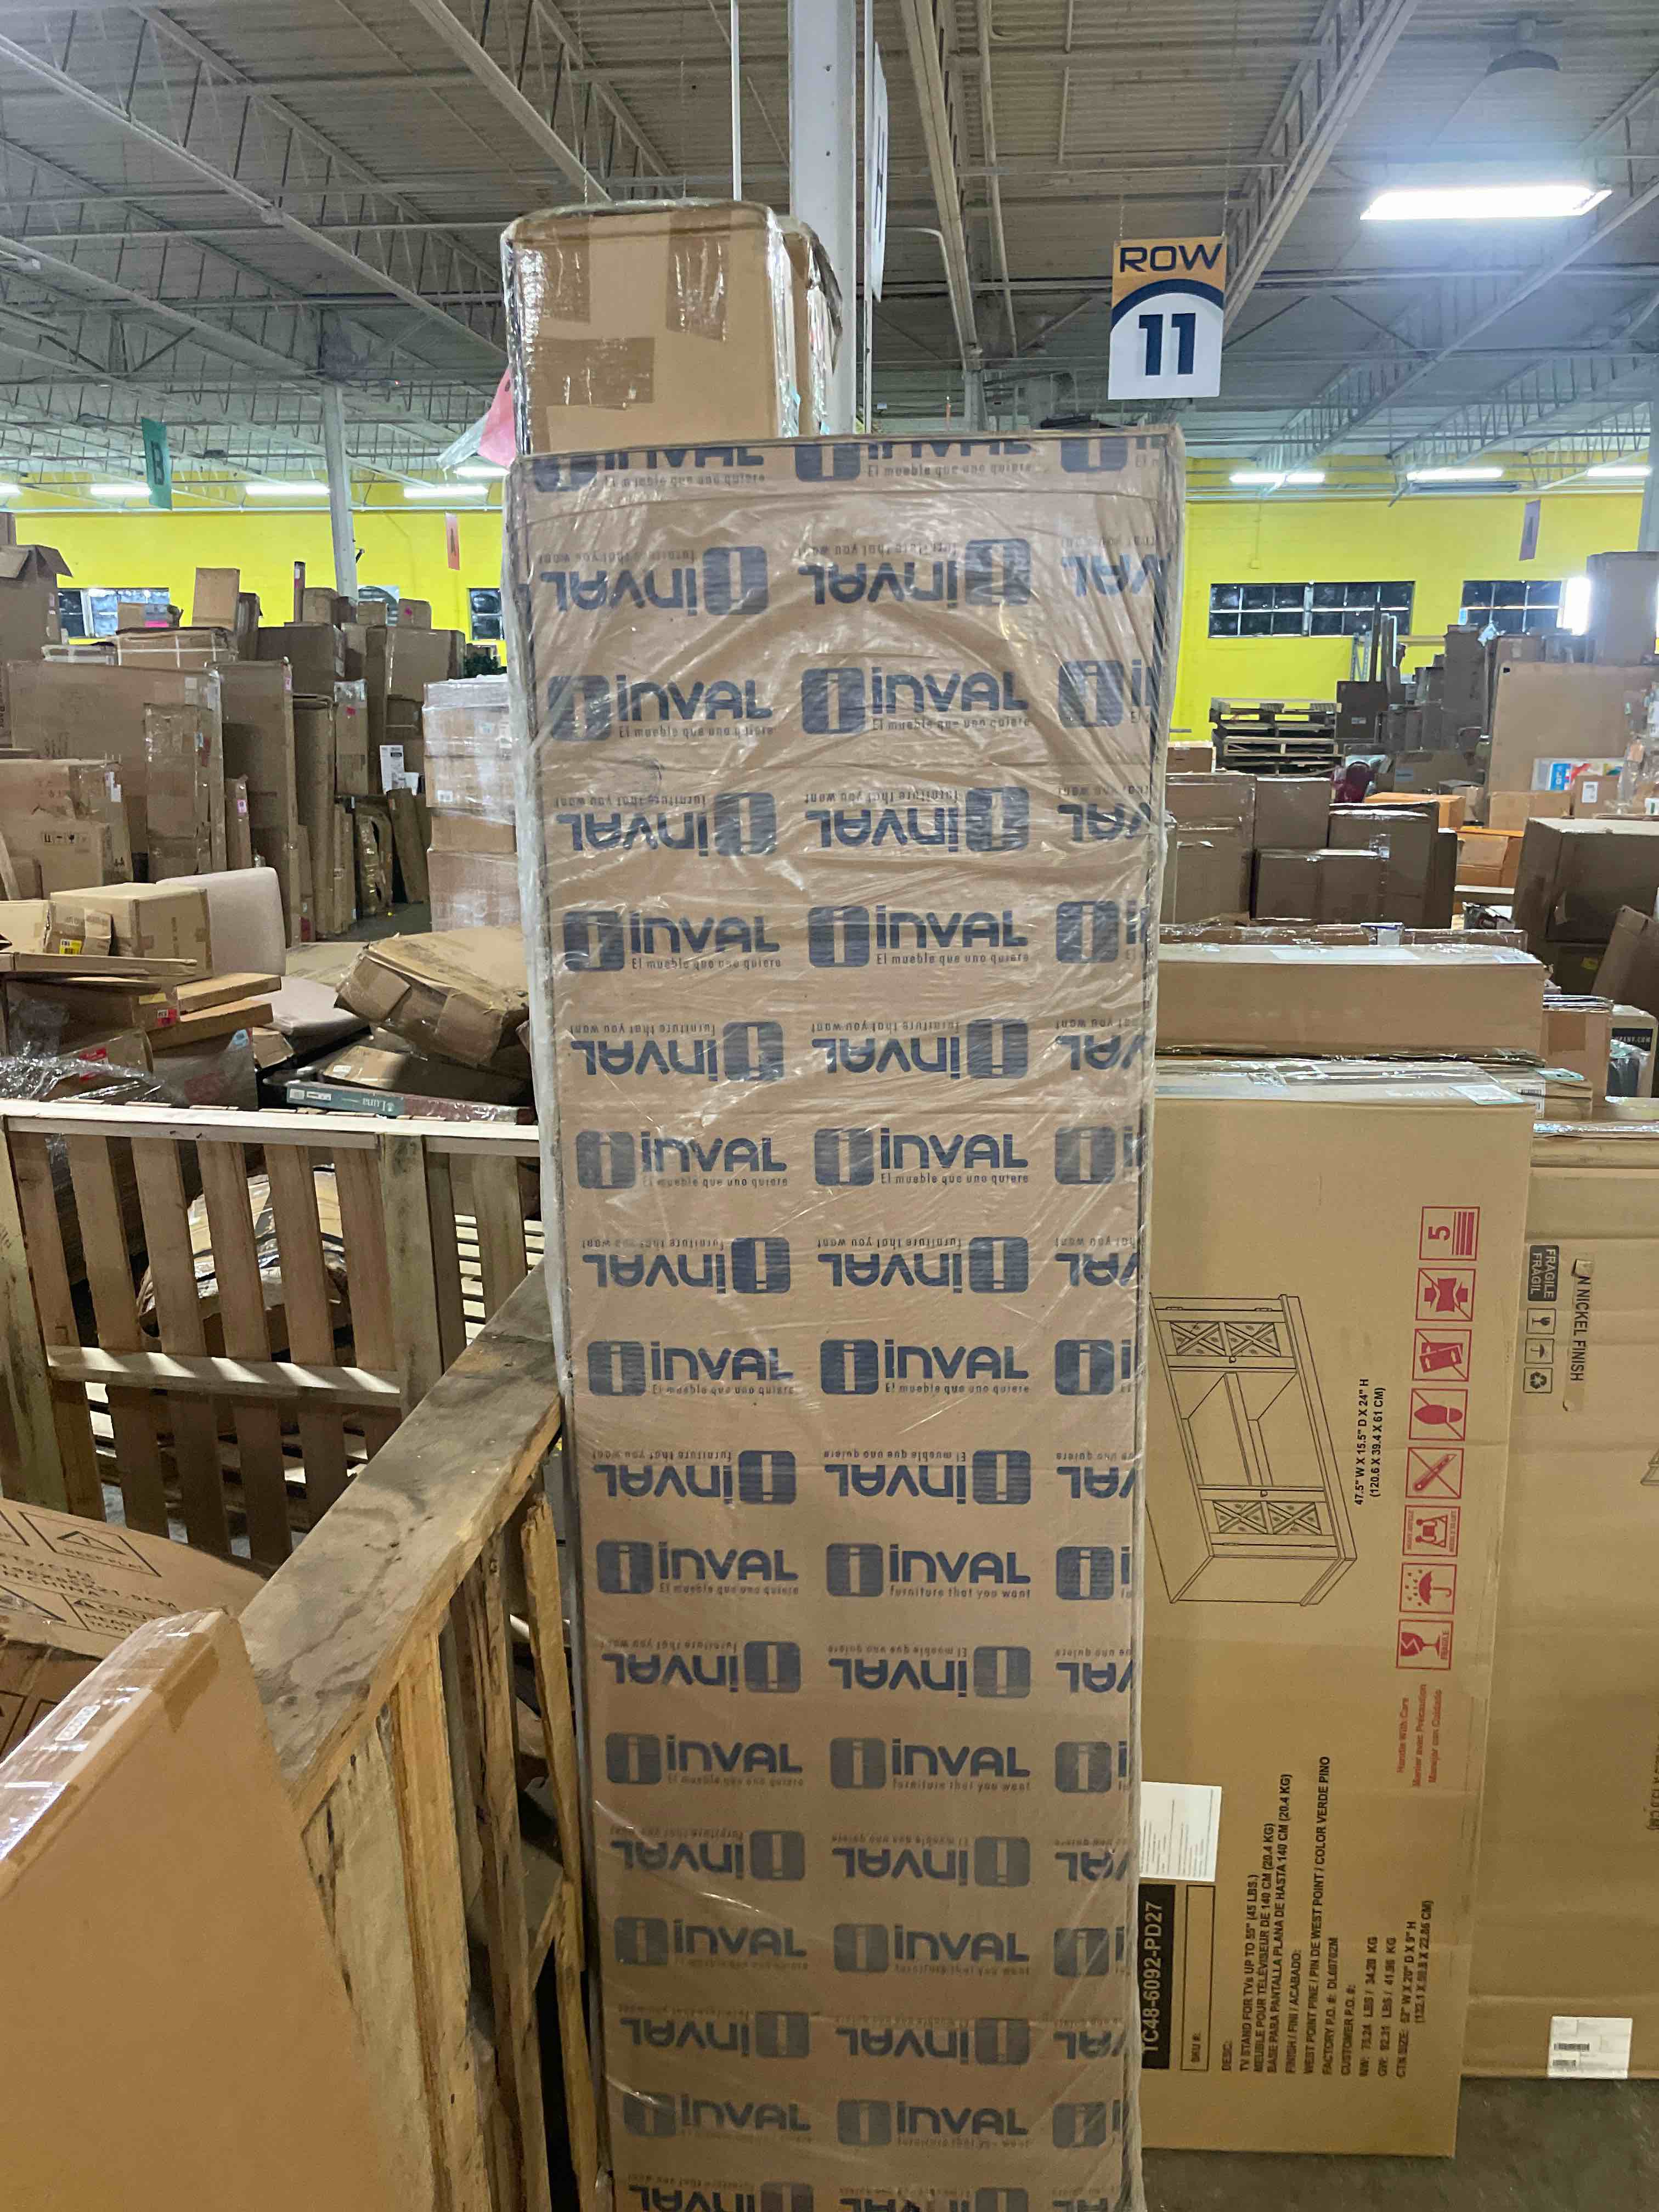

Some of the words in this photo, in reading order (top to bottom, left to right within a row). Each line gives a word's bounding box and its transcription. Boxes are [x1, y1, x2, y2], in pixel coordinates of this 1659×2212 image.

[1119, 244, 1222, 273] ROW
[1138, 313, 1196, 376] 11
[151, 441, 165, 486] B
[877, 953, 888, 964] El
[939, 955, 960, 966] que
[629, 1024, 656, 1035] that
[881, 1174, 891, 1183] El
[895, 1174, 936, 1183] mueble
[941, 1175, 961, 1185] que
[991, 1175, 1029, 1185] quiere
[817, 1238, 846, 1248] want
[851, 1237, 873, 1247] you
[877, 1238, 902, 1248] that
[1427, 1226, 1450, 1241] 5
[1530, 1252, 1542, 1295] FRAGIL
[1544, 1248, 1556, 1299] FRAGILE
[1573, 1289, 1590, 1336] NICKEL
[1570, 1340, 1587, 1381] FINISH
[885, 1383, 895, 1392] El
[899, 1383, 940, 1392] mueble
[944, 1385, 964, 1394] que
[968, 1384, 989, 1392] uno
[993, 1384, 1030, 1395] quiere
[1359, 1389, 1368, 1407] 24"
[1374, 1387, 1386, 1408] CM)
[1373, 1411, 1383, 1423] 61
[1357, 1429, 1367, 1454] 15.5"
[1372, 1435, 1382, 1455] 39.4
[1356, 1467, 1365, 1477] W
[1355, 1480, 1364, 1505] 47.5"
[1369, 1467, 1381, 1498] (120.6
[949, 1586, 972, 1598] that
[1318, 1756, 1330, 1784] PINO
[1280, 1774, 1293, 1795] KG)
[1279, 1796, 1291, 1822] (20.4
[1317, 1786, 1329, 1824] VERDE
[1264, 1823, 1276, 1843] KG)
[1278, 1825, 1289, 1841] CM
[1277, 1843, 1288, 1861] 140
[1315, 1826, 1327, 1865] COLOR
[1262, 1873, 1272, 1889] CM
[1275, 1865, 1286, 1900] HASTA
[1312, 1874, 1324, 1906] POINT
[1262, 1893, 1271, 1910] 140
[1274, 1903, 1285, 1918] DE
[1260, 1912, 1270, 1927] DE
[1311, 1908, 1322, 1939] WEST
[1406, 1921, 1415, 1929] H
[1273, 1920, 1284, 1956] PLANA
[1367, 1936, 1378, 1953] KG
[1386, 1937, 1396, 1953] KG
[1245, 1942, 1255, 1957] TO
[1310, 1940, 1321, 1958] DE
[1404, 1955, 1414, 1963] D
[1142, 1901, 1163, 2052] TC48-6092-PD27
[1244, 1960, 1254, 1974] UP
[1271, 1959, 1282, 2012] PANTALLA
[1243, 1998, 1252, 2020] FOR
[1256, 1998, 1266, 2028] POUR
[1269, 2015, 1280, 2043] PARA
[1306, 2011, 1317, 2043] POINT
[1241, 2023, 1251, 2057] STAND
[1240, 2059, 1249, 2072] TV
